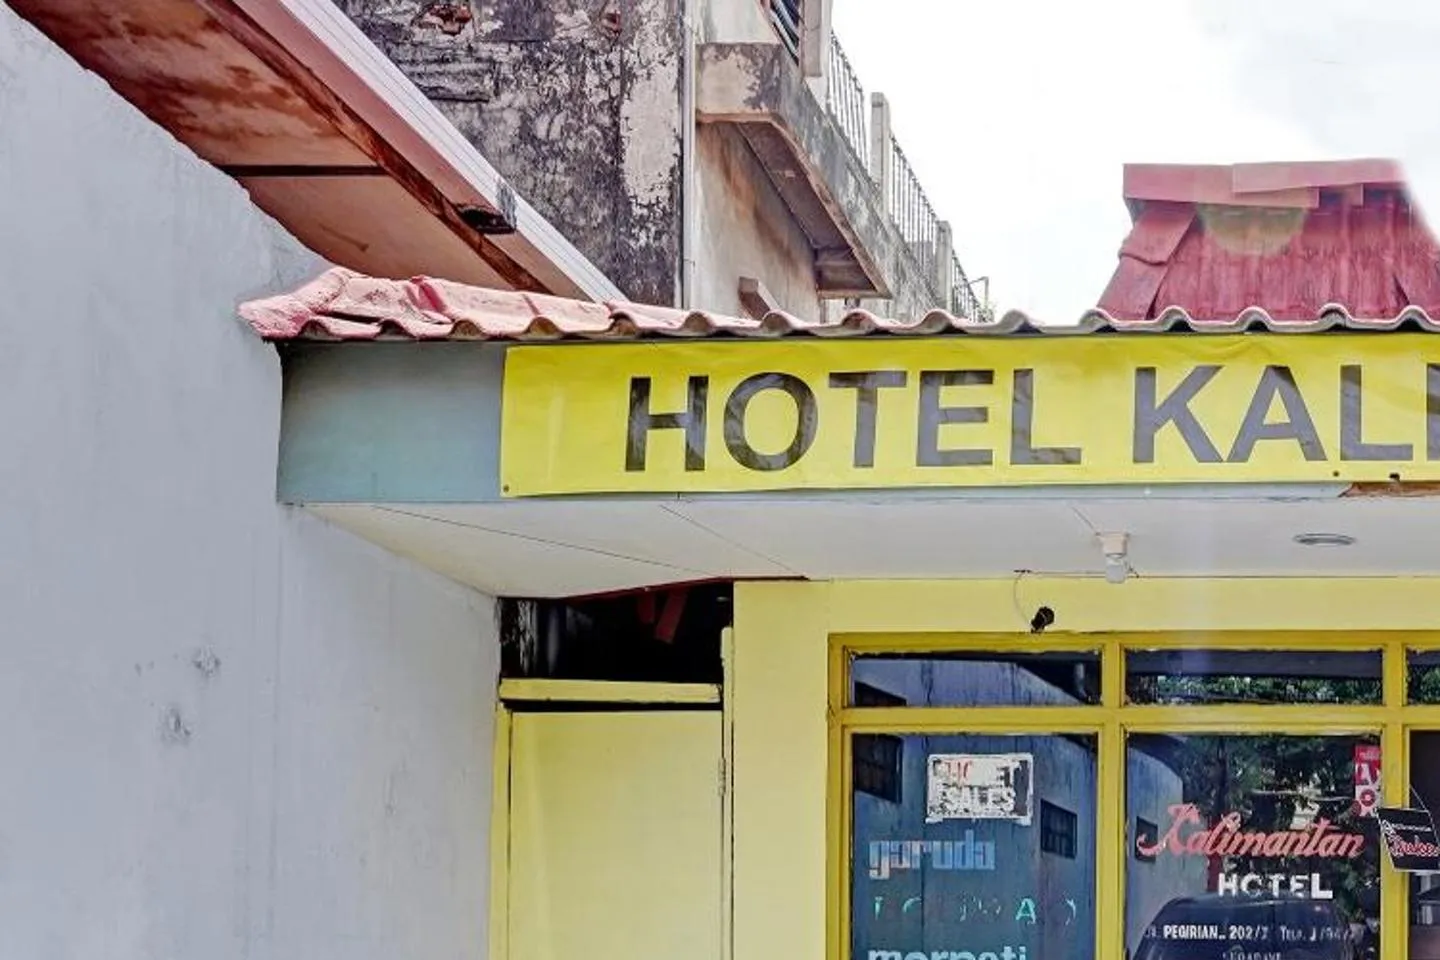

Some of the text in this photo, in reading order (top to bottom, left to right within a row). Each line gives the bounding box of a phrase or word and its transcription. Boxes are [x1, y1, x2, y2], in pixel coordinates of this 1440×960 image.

[624, 368, 1081, 471] HOTEL
[868, 829, 996, 880] garuda
[1136, 803, 1365, 858] Kalimantan
[1218, 872, 1333, 899] HOTEL
